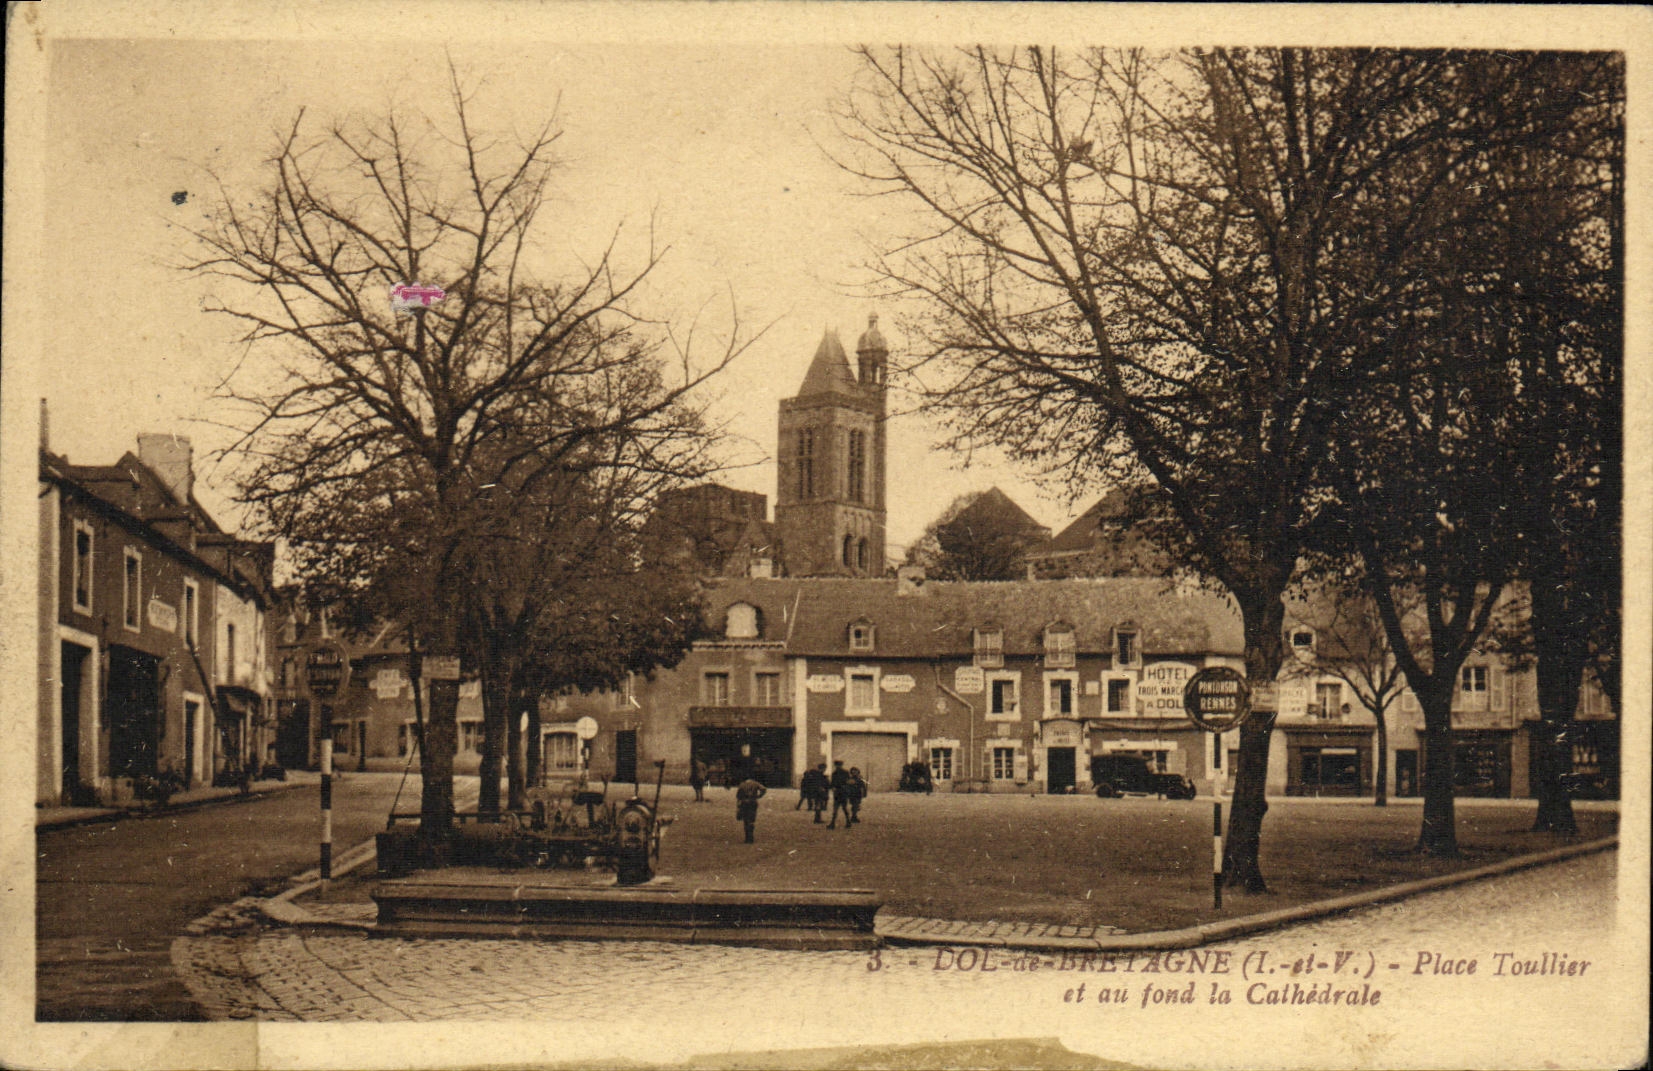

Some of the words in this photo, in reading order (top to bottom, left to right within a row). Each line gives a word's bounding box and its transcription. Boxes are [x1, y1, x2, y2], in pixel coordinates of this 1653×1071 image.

[1138, 686, 1158, 696] TROIS
[1157, 698, 1186, 709] DOL
[1199, 697, 1237, 711] RENNES
